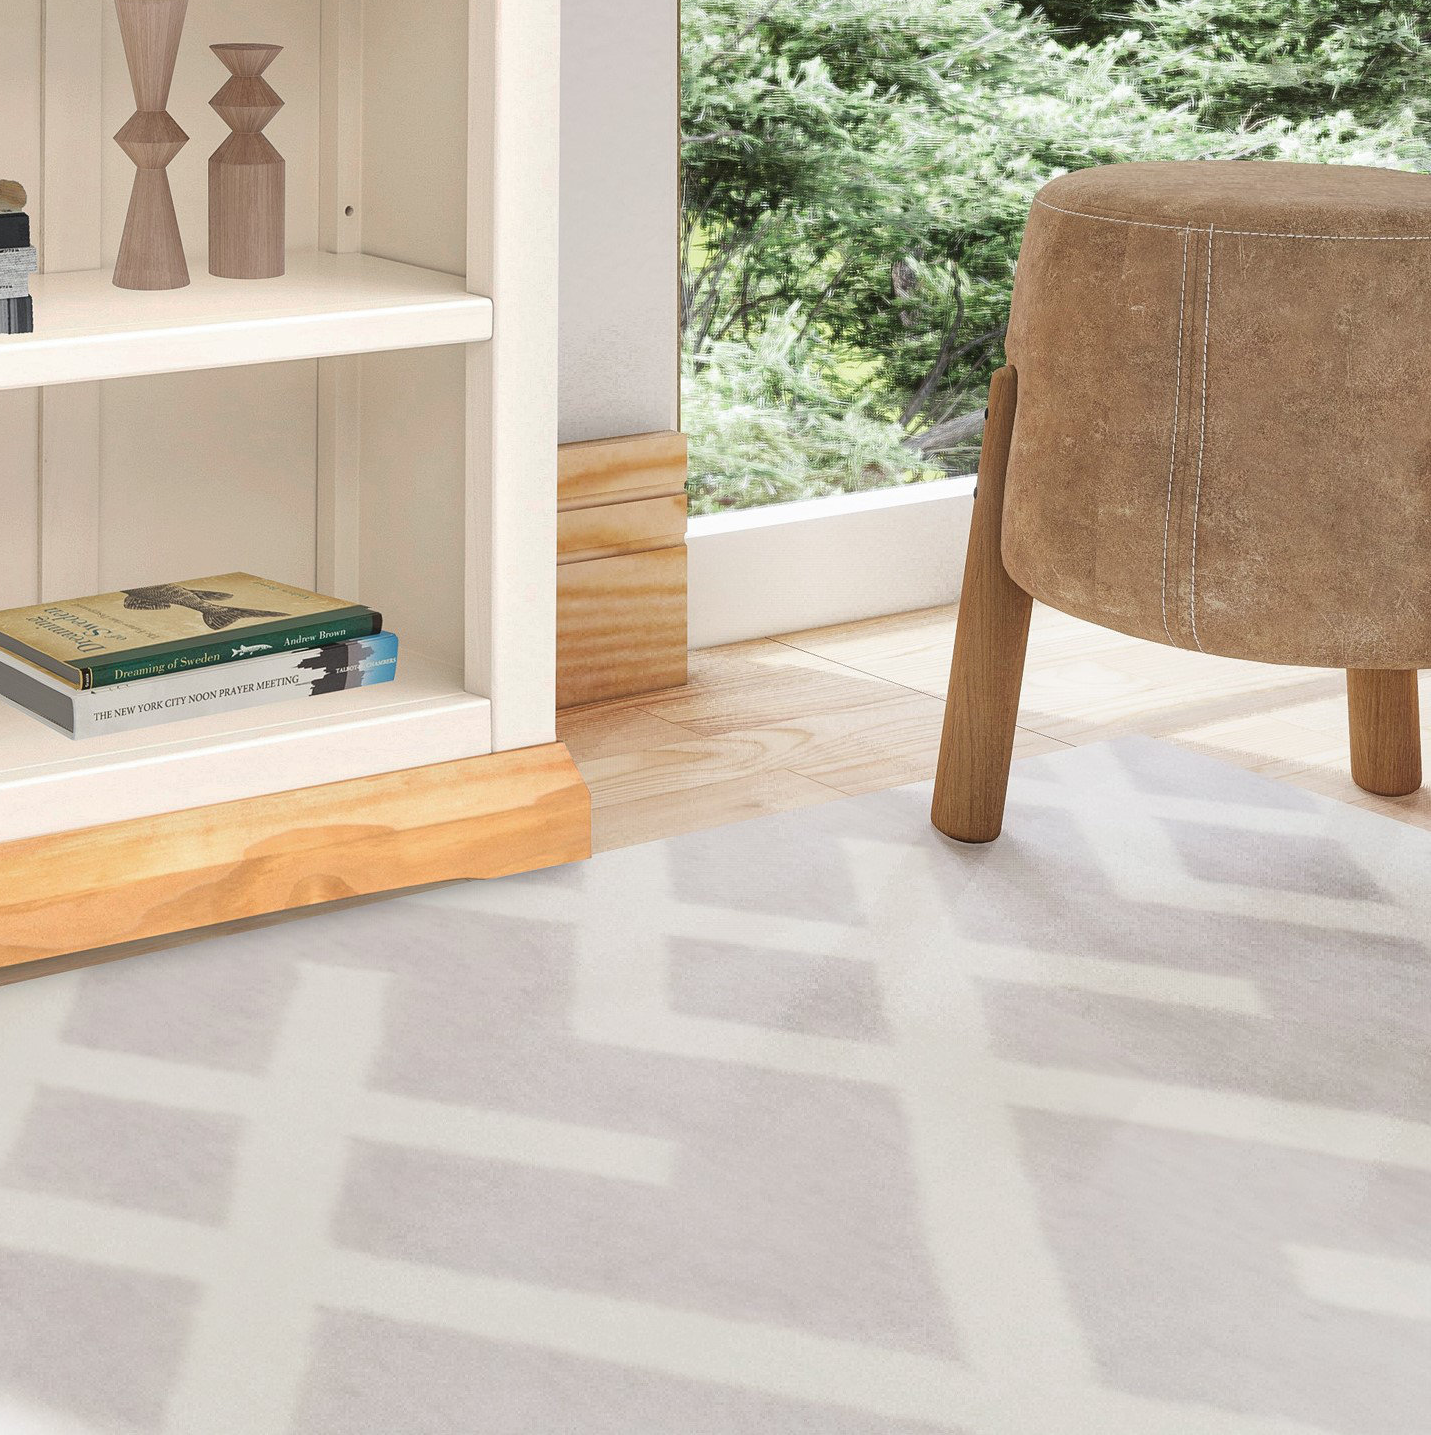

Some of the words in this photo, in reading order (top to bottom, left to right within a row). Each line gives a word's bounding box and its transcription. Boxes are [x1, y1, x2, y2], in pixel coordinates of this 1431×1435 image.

[284, 634, 317, 647] Andrew
[319, 628, 346, 640] Brown
[115, 664, 165, 680] Dreaming
[167, 659, 178, 670] of
[180, 653, 221, 667] Sweden
[94, 710, 112, 721] THE
[114, 706, 135, 717] NEW
[138, 700, 163, 713] YORK
[165, 696, 187, 708] CITY
[188, 690, 217, 703] NOON
[219, 681, 255, 698] PRAYER
[256, 675, 300, 691] MEETING
